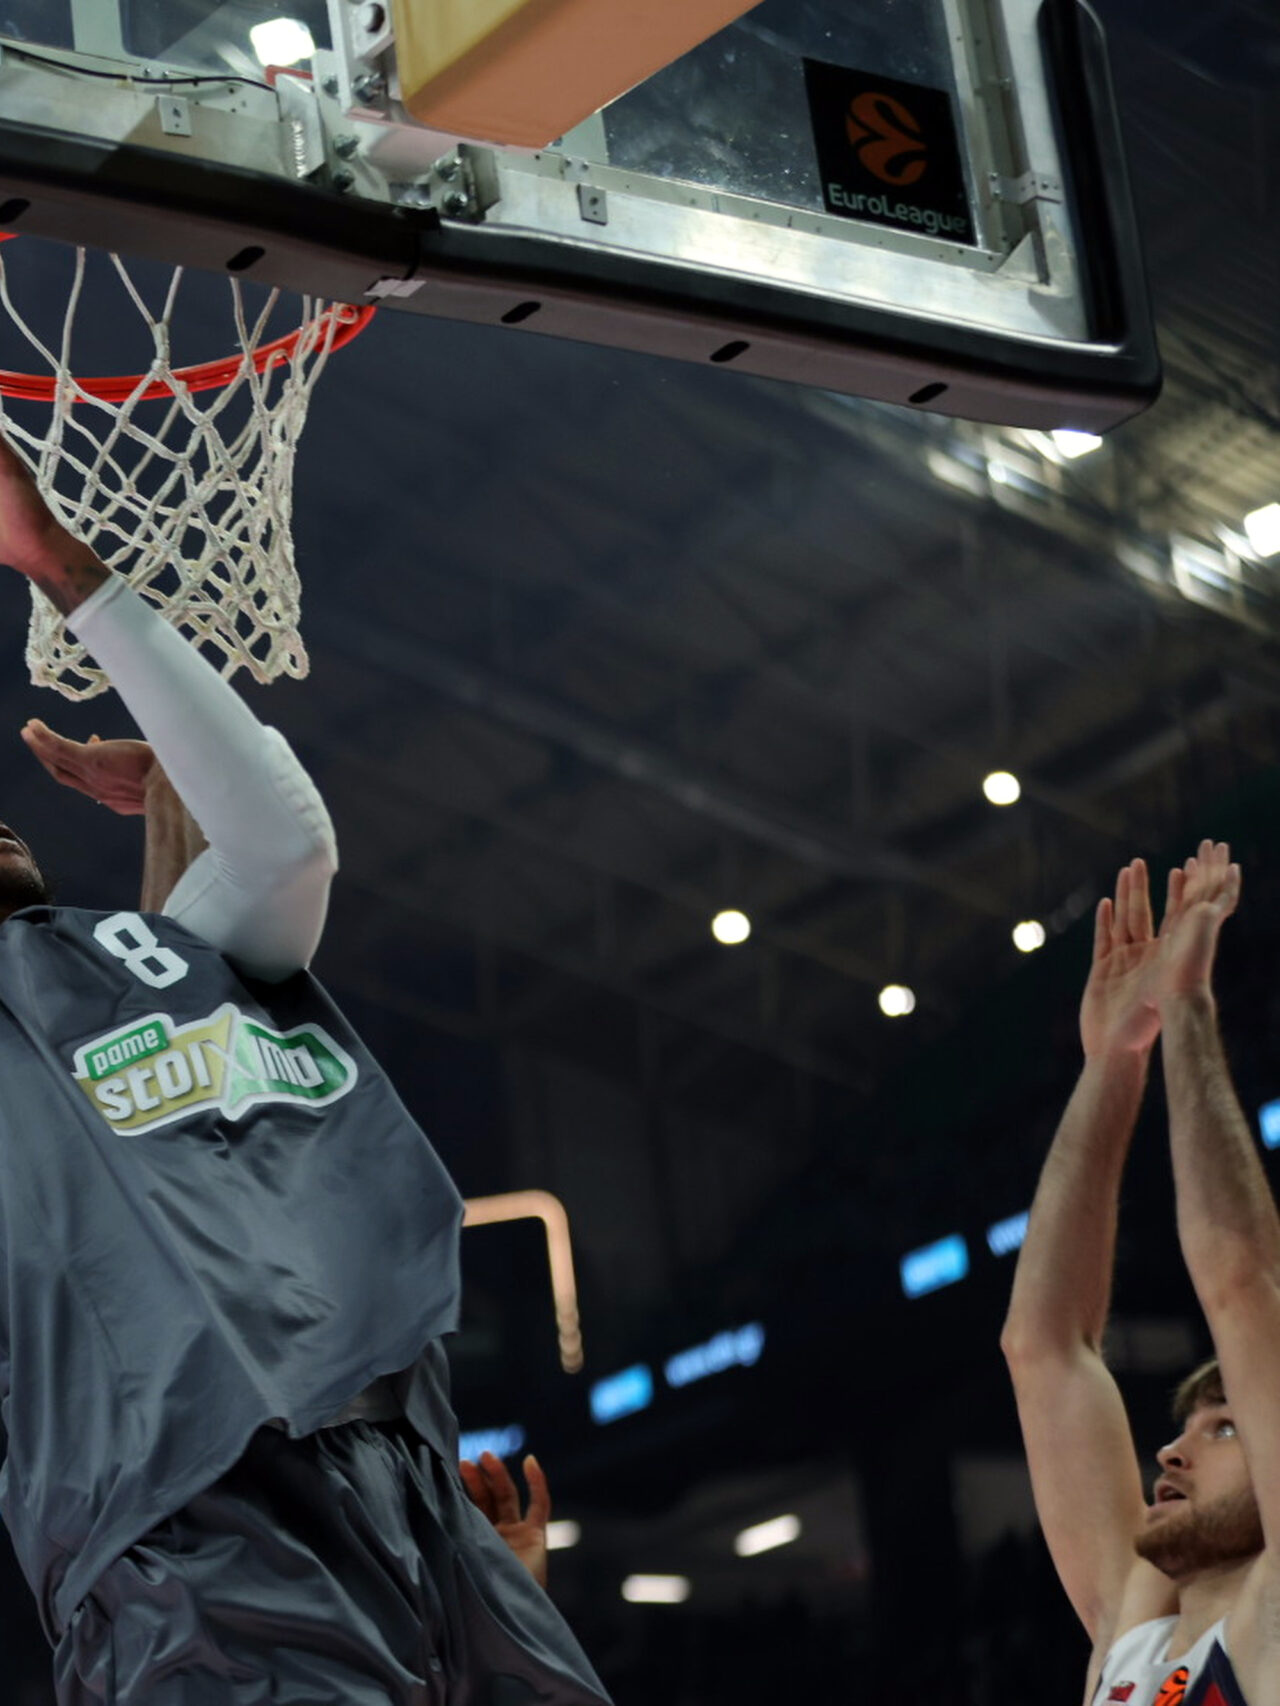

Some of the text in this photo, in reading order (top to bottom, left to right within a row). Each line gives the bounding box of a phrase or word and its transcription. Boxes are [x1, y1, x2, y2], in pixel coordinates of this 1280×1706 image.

[828, 183, 967, 235] EuroLeague
[93, 911, 189, 989] 8
[91, 1026, 160, 1076] pame
